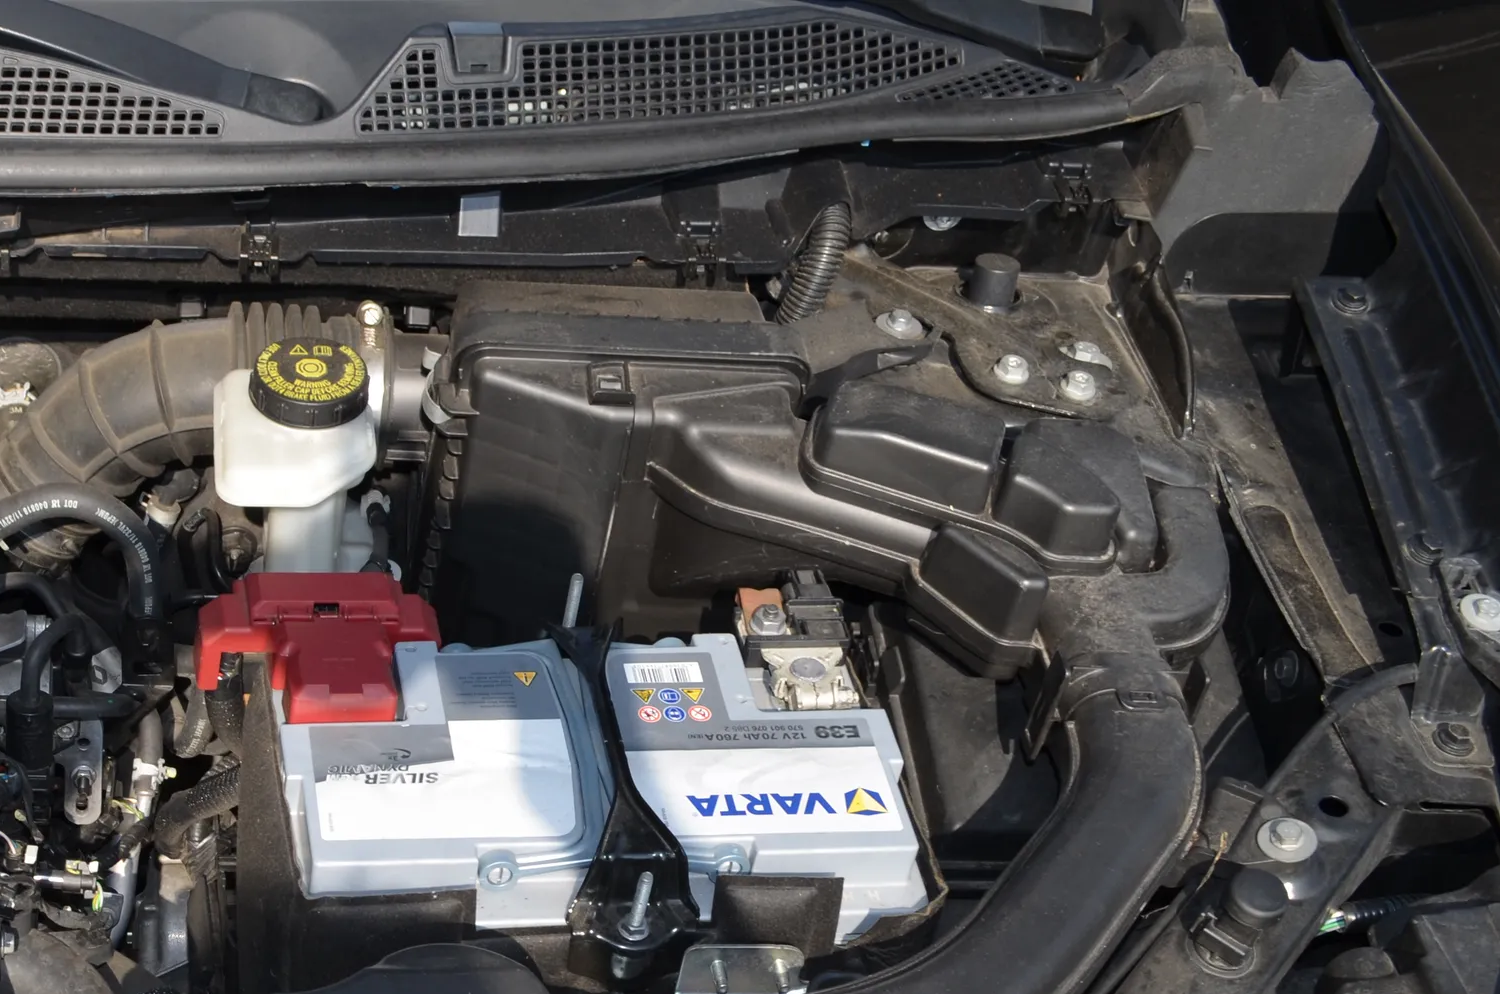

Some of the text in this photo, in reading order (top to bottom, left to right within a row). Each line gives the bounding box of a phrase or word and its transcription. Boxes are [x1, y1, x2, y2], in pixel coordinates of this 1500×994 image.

[273, 376, 294, 390] FILLER
[295, 385, 310, 394] CAP
[312, 384, 340, 395] BEFORE
[294, 379, 331, 388] WARNING
[284, 391, 309, 400] BRAKE
[310, 393, 331, 402] FLUID
[331, 387, 350, 399] FROM
[744, 732, 777, 741] 70Ah
[782, 732, 807, 740] 12V
[815, 725, 861, 739] E39
[364, 772, 439, 785] SILVER
[686, 792, 837, 817] VARTA
